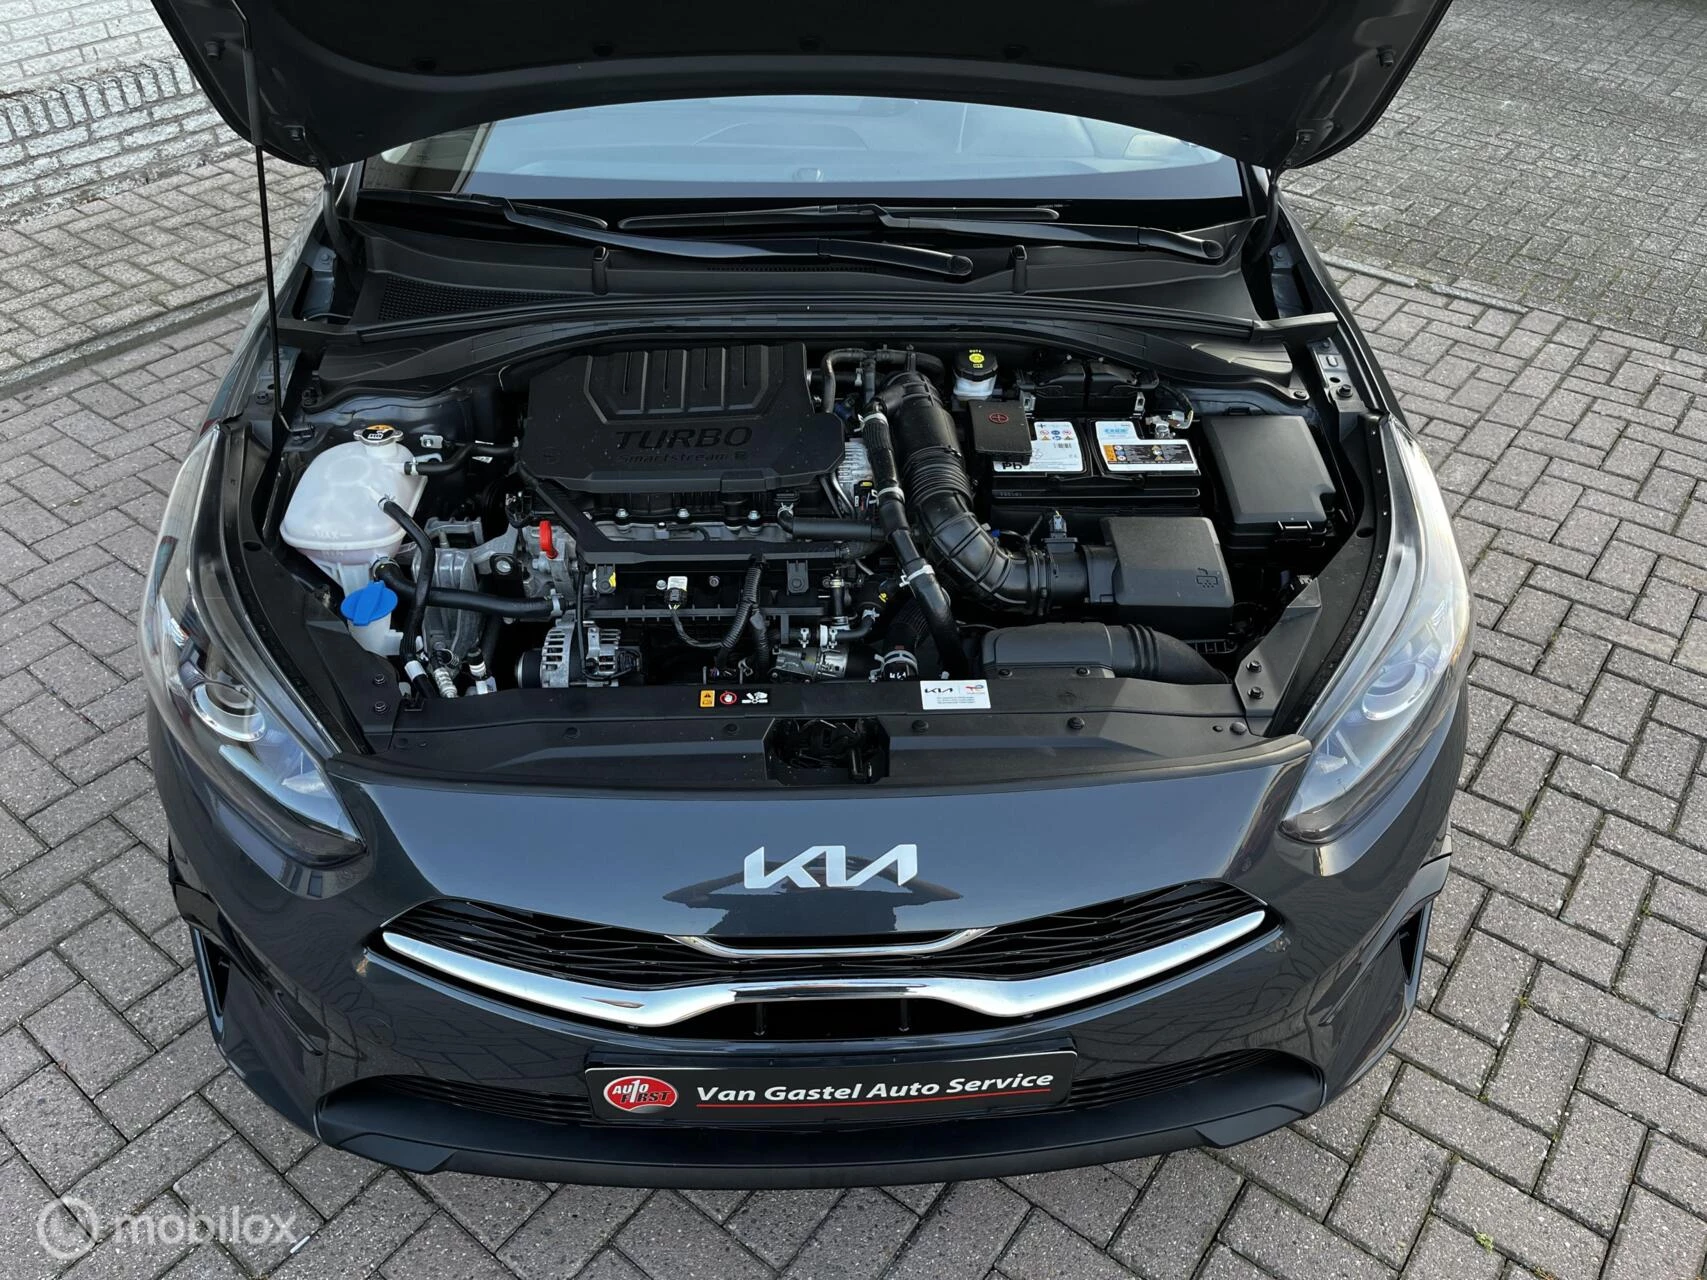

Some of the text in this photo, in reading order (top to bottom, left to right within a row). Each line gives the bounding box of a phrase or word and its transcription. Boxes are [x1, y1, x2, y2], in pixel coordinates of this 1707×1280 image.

[616, 427, 752, 449] TURBO
[744, 844, 918, 889] KIA
[697, 1073, 1054, 1101] Van Gastel Auto Service
